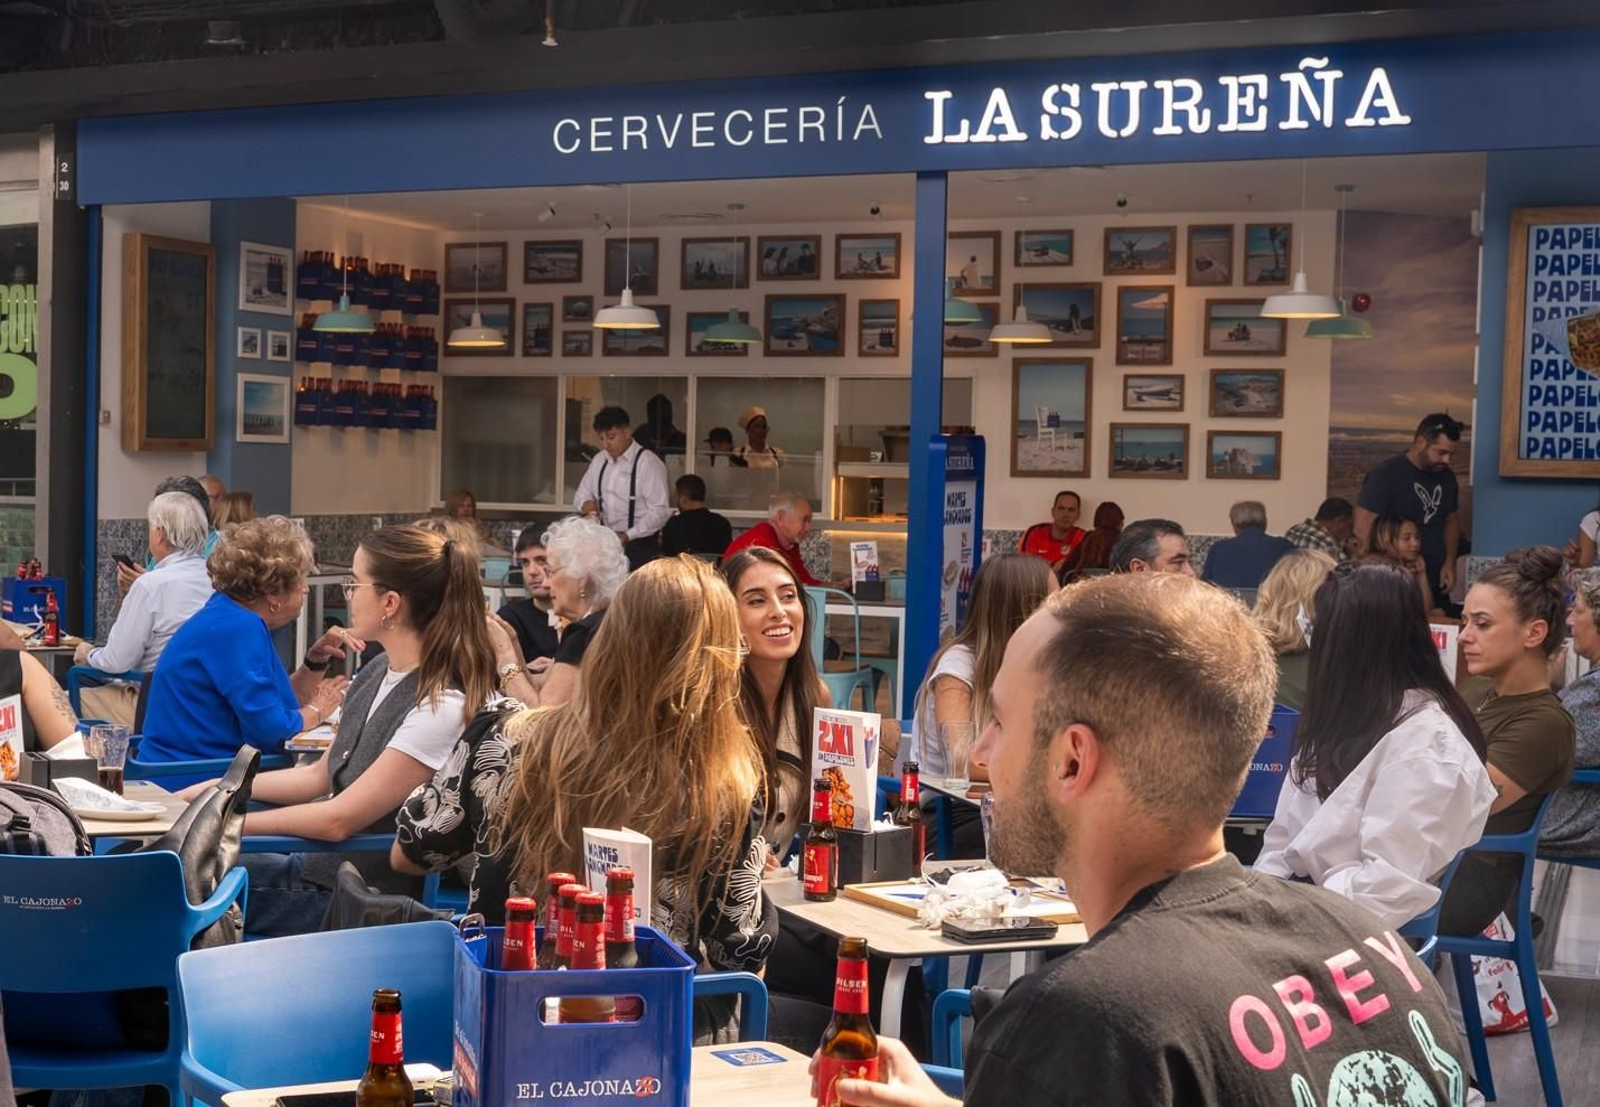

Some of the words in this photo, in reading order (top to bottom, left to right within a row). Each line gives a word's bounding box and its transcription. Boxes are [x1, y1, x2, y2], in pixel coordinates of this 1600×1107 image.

[553, 95, 883, 154] CERVECERÍA
[923, 86, 1028, 145] LA
[1040, 56, 1412, 141] SUREÑA
[60, 162, 69, 173] 2
[59, 181, 69, 191] 30
[1528, 385, 1600, 407] PAPEL
[1527, 411, 1600, 434] PAPEL
[3, 895, 19, 905] EL
[1229, 930, 1422, 1070] OBEY
[516, 1082, 544, 1099] EL
